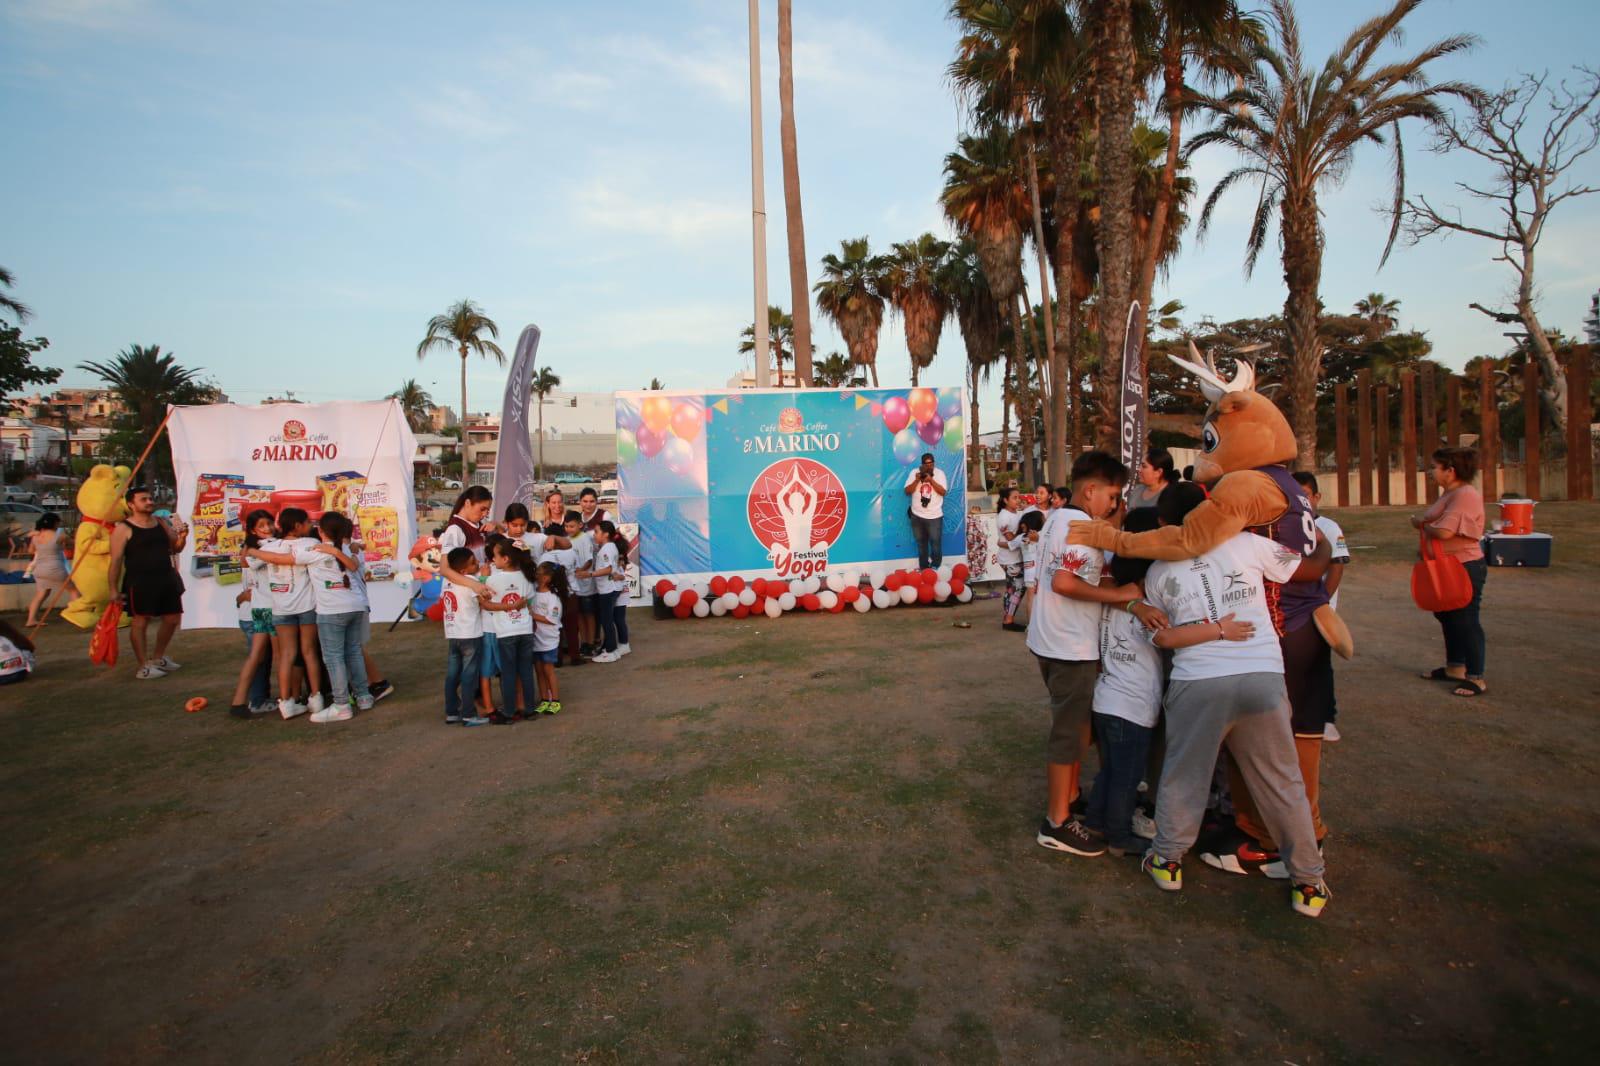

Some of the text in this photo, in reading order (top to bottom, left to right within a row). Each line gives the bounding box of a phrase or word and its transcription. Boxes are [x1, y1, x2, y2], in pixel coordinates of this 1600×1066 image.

[263, 443, 338, 461] MARINO
[754, 433, 841, 454] MARINO
[1301, 510, 1318, 557] 9
[793, 550, 828, 560] Festival
[774, 552, 828, 579] Yoga
[1221, 586, 1258, 605] IMDEM
